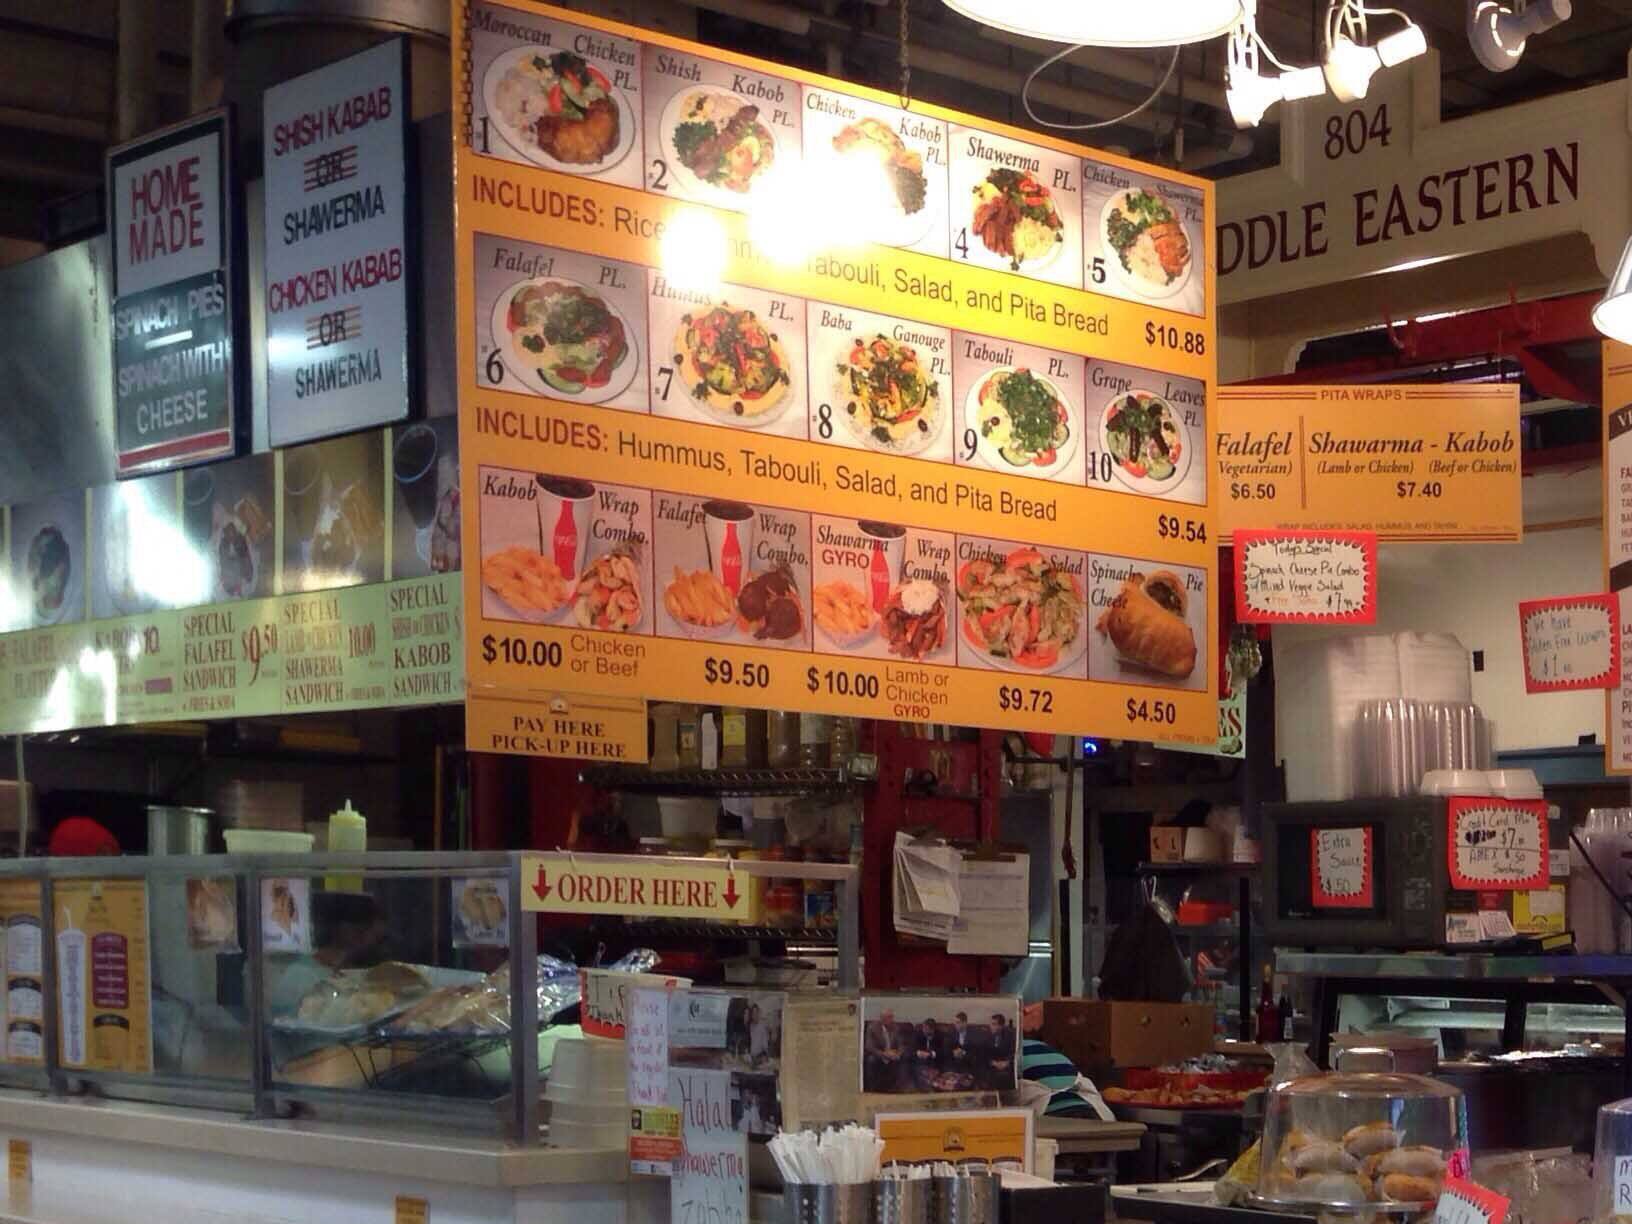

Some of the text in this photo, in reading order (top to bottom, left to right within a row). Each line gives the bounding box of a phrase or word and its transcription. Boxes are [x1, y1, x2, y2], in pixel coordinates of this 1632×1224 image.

[472, 9, 635, 66] Moroccan Chicken
[656, 56, 784, 103] Shish Kabob
[274, 87, 392, 157] SHISH KABAB
[899, 118, 942, 144] Kabob
[1324, 103, 1391, 160] 804
[967, 137, 1039, 173] Shawerma
[131, 157, 200, 219] HOME
[1084, 165, 1130, 189] Chicken
[284, 186, 385, 244] SHAWERMA
[1215, 143, 1579, 276] DDLE EASTERN
[129, 202, 204, 264] MADE
[493, 248, 553, 280] Falafel
[269, 248, 402, 313] CHICKEN KABAB
[821, 309, 853, 331] Baba
[967, 289, 1205, 356] and Pita Bread $10.88
[964, 339, 1014, 366] Tabouli
[295, 349, 382, 399] SHAWERMA
[1092, 367, 1132, 392] Grape
[1321, 389, 1401, 400] PITA WRAPS
[137, 390, 208, 434] CHEESE
[1216, 432, 1291, 463] Falafel
[1309, 430, 1514, 454] Shawarma Kabob
[484, 474, 640, 516] Kabob Wrap
[1231, 483, 1275, 499] $6.50
[1397, 481, 1442, 498] $7.40
[759, 512, 797, 538] Wrap
[910, 481, 1207, 544] and Pita Bread $9.54
[917, 539, 950, 564] Wrap
[390, 583, 448, 611] SPECIAL
[185, 639, 236, 664] FALAFEL
[394, 642, 451, 668] KABOB
[482, 634, 646, 667] $10.00 Chicken
[183, 666, 236, 691] SANDWICH
[571, 658, 638, 677] or Beef
[705, 657, 769, 688] $9.50
[286, 682, 343, 706] SANDWICH
[394, 671, 450, 698] SANDWICH
[807, 666, 929, 699] $10.00 Lamb
[886, 684, 948, 704] Chicken
[894, 705, 930, 719] GYRO
[999, 687, 1053, 714] $9.72
[1127, 700, 1176, 724] $4.50
[512, 716, 605, 738] PAY HERE
[492, 735, 626, 758] PICK-UP HERE
[557, 873, 717, 908] ORDER HERE
